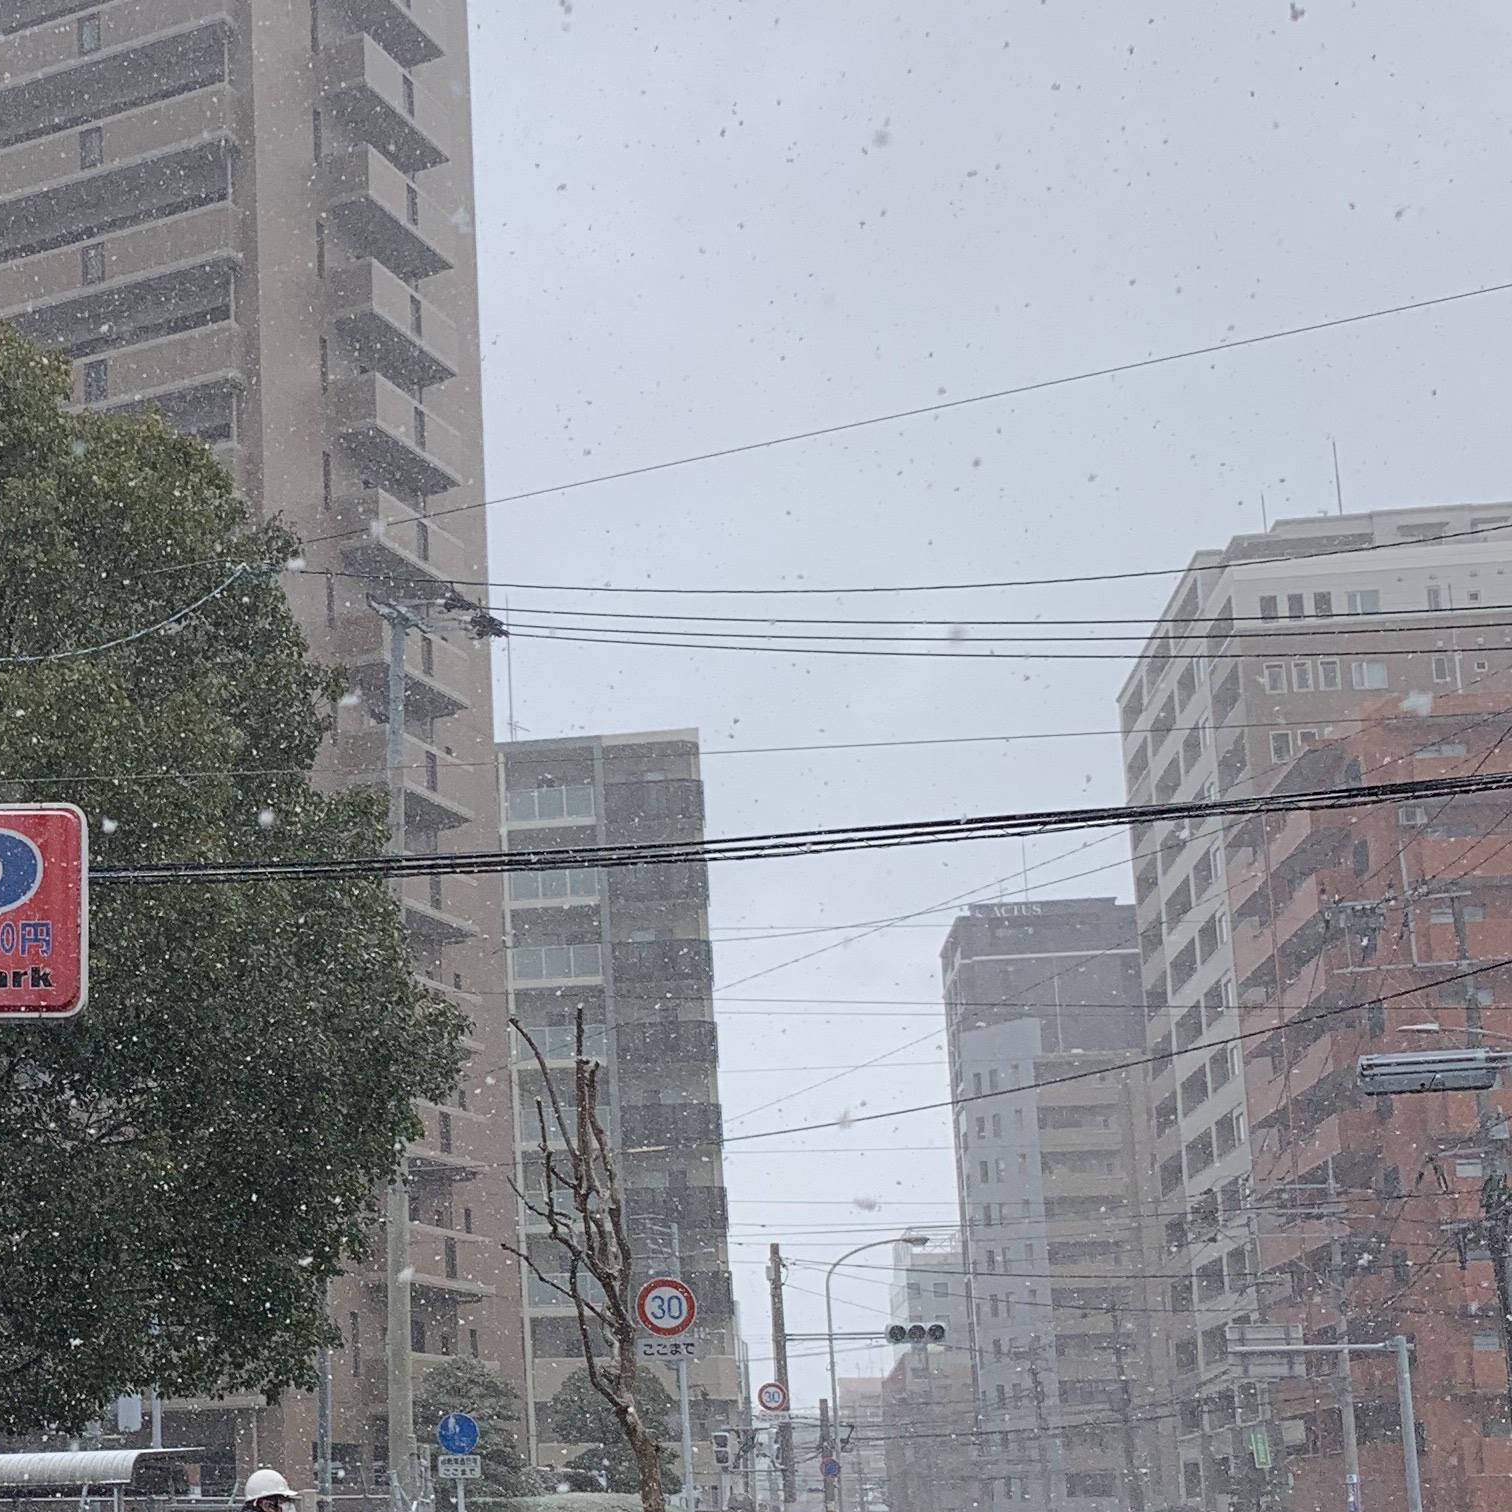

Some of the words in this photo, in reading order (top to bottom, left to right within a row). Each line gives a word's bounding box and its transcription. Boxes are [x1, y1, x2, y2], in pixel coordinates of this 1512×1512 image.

[650, 1295, 683, 1321] 30
[643, 1342, 695, 1356] ここまで
[764, 1390, 780, 1404] 30
[442, 1468, 476, 1477] ここまで
